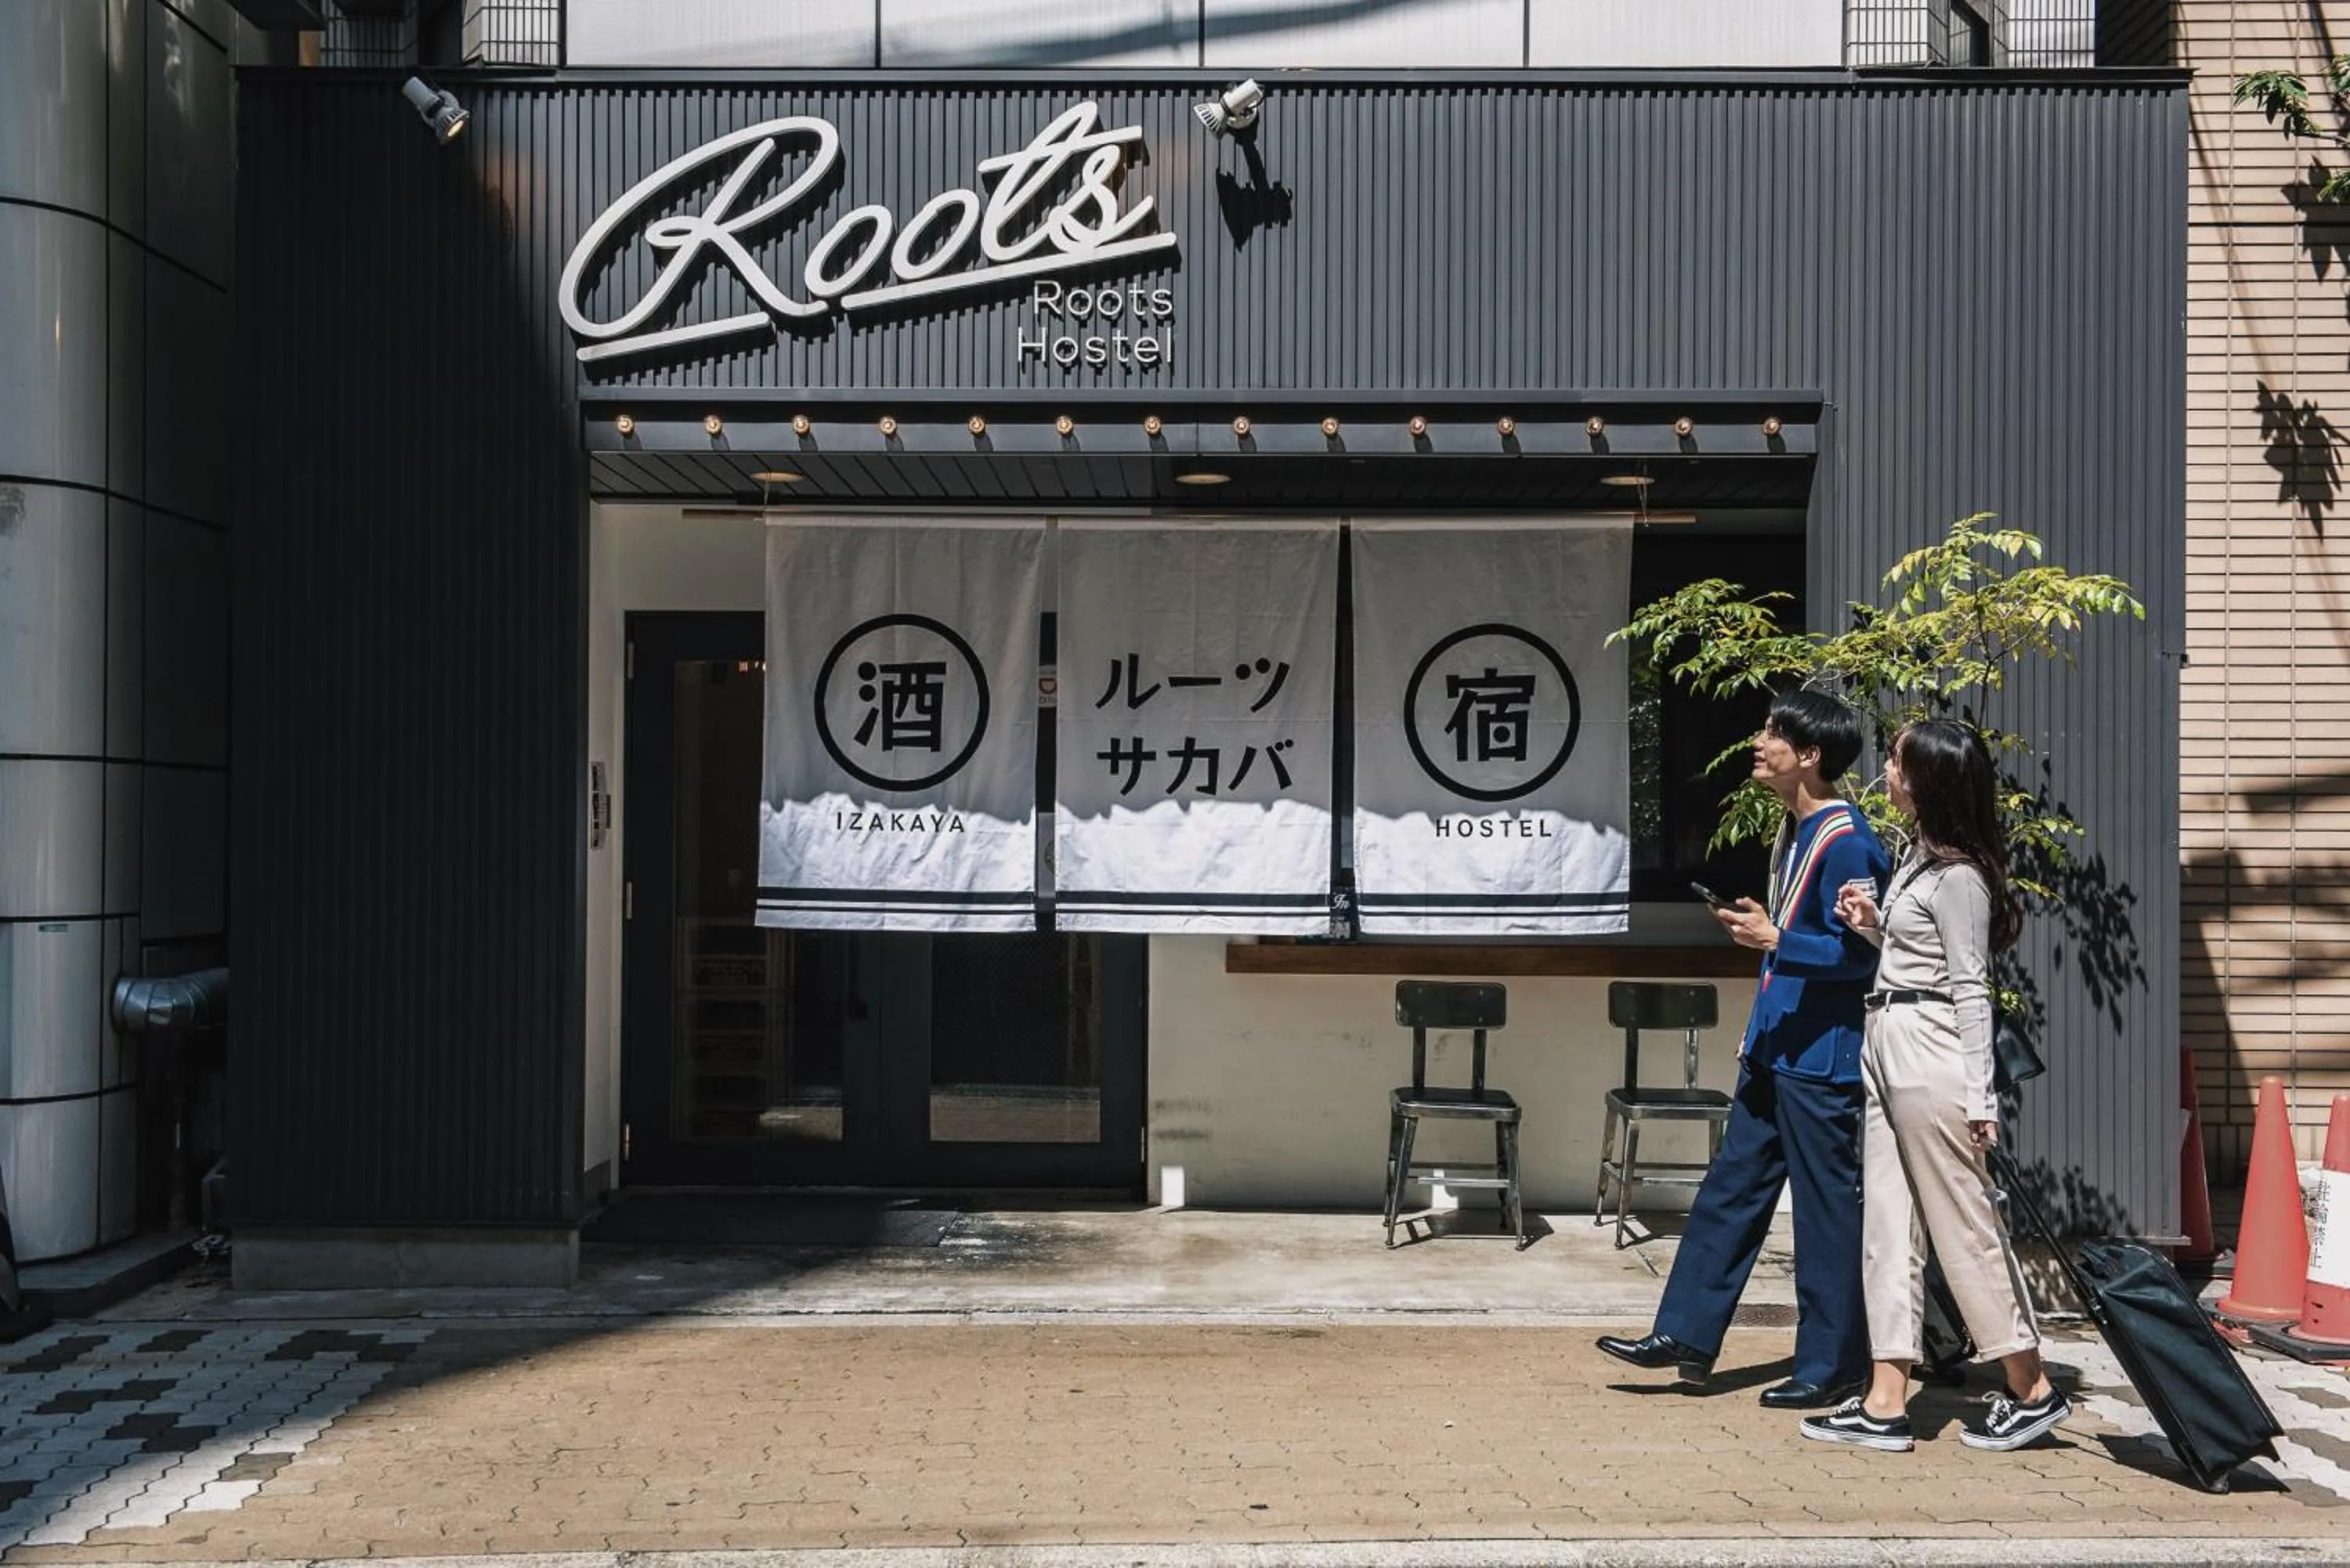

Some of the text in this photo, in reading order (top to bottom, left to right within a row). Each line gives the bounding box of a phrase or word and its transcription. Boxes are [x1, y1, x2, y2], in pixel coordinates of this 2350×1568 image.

[559, 100, 1177, 363] Roots
[1034, 280, 1173, 315] Roots
[1018, 327, 1171, 363] Hostel
[854, 661, 947, 752] 酒
[1096, 653, 1290, 712] ルーツ
[1444, 667, 1536, 762] 宿
[1096, 736, 1294, 796] サカバ
[837, 811, 965, 833] IZAKAYA
[1436, 818, 1552, 837] HOSTEL
